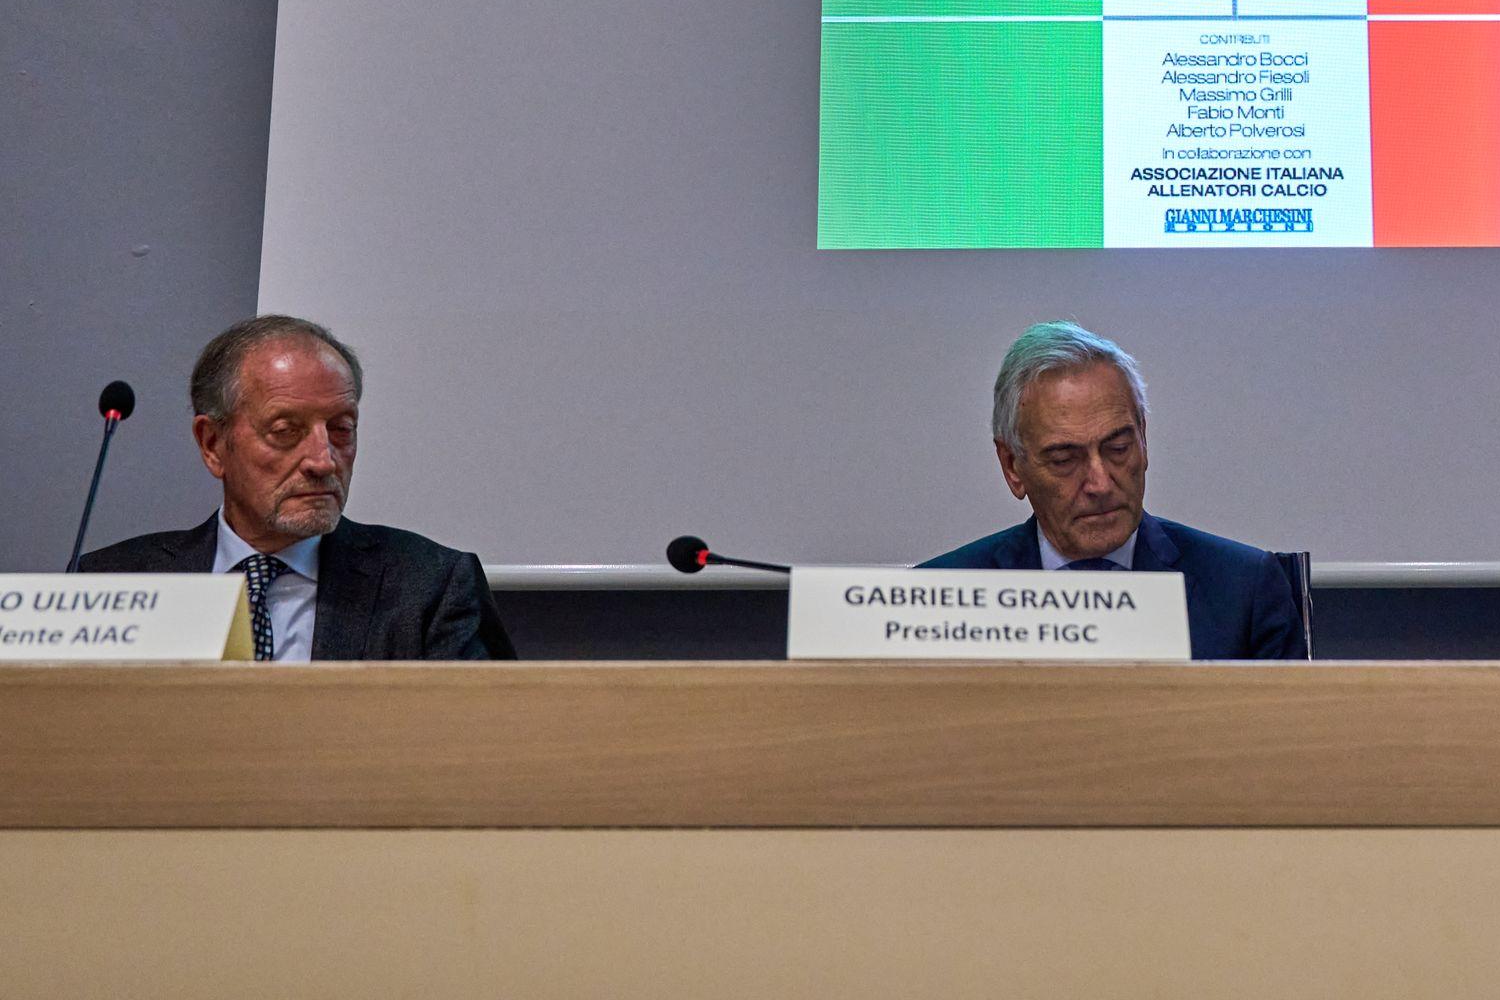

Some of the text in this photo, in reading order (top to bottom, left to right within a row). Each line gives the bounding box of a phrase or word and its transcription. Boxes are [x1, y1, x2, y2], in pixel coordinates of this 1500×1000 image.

[1200, 35, 1270, 44] CONTRIBUTI
[1162, 52, 1308, 66] Alessandro Bocci
[1162, 70, 1309, 84] Alessandro Fiesoli
[1180, 88, 1292, 101] Massimo Grilli
[1188, 106, 1284, 119] Fabio Monti
[1166, 124, 1305, 137] Alberto Polverosi
[1177, 147, 1280, 159] collaborazione
[1283, 149, 1311, 159] con
[1131, 168, 1344, 180] ASSOCIAZIONE ITALIANA
[1148, 184, 1327, 196] ALLENATORI CALCIO
[1165, 209, 1312, 223] GIANNI MARCHESINI
[33, 591, 158, 611] ULIVIERI
[844, 586, 1137, 610] GABRIELE GRAVINA
[0, 625, 140, 644] ente AIAC
[885, 622, 1099, 643] Presidente FIGC
